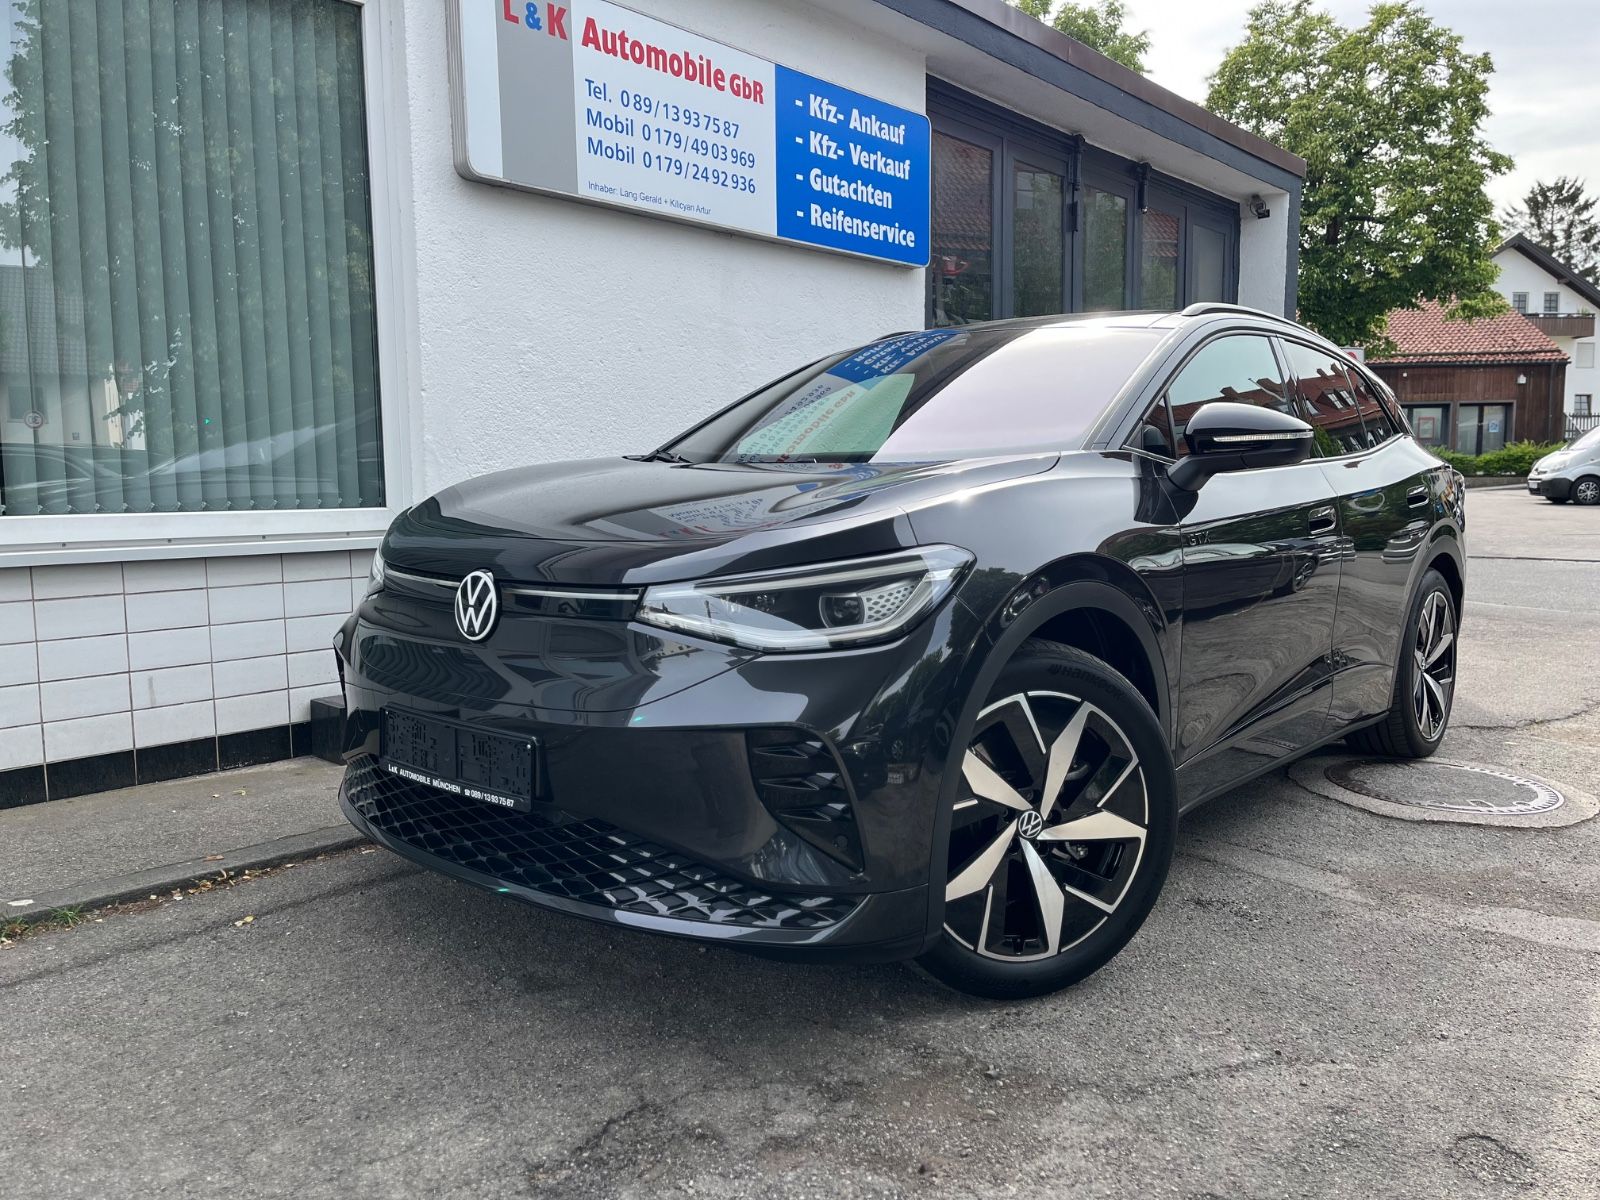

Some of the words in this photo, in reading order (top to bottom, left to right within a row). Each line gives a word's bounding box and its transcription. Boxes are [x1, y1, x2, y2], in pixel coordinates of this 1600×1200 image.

[581, 16, 726, 92] Automobile
[729, 73, 765, 105] GbR
[585, 78, 612, 103] Tel.
[586, 107, 634, 137] Mobil
[809, 93, 845, 124] Kfz-
[849, 108, 905, 145] Ankauf
[587, 136, 635, 165] Mobil
[809, 130, 845, 160] Kfz-
[849, 142, 911, 180] Verkauf
[588, 181, 617, 194] Inhaber:
[620, 187, 638, 201] Lang
[639, 191, 662, 205] Gerald
[809, 167, 892, 209] Gutachten
[810, 203, 915, 248] Reifenservice
[399, 768, 431, 785] AUTOMOBILE
[432, 778, 461, 794] MÜNCHEN
